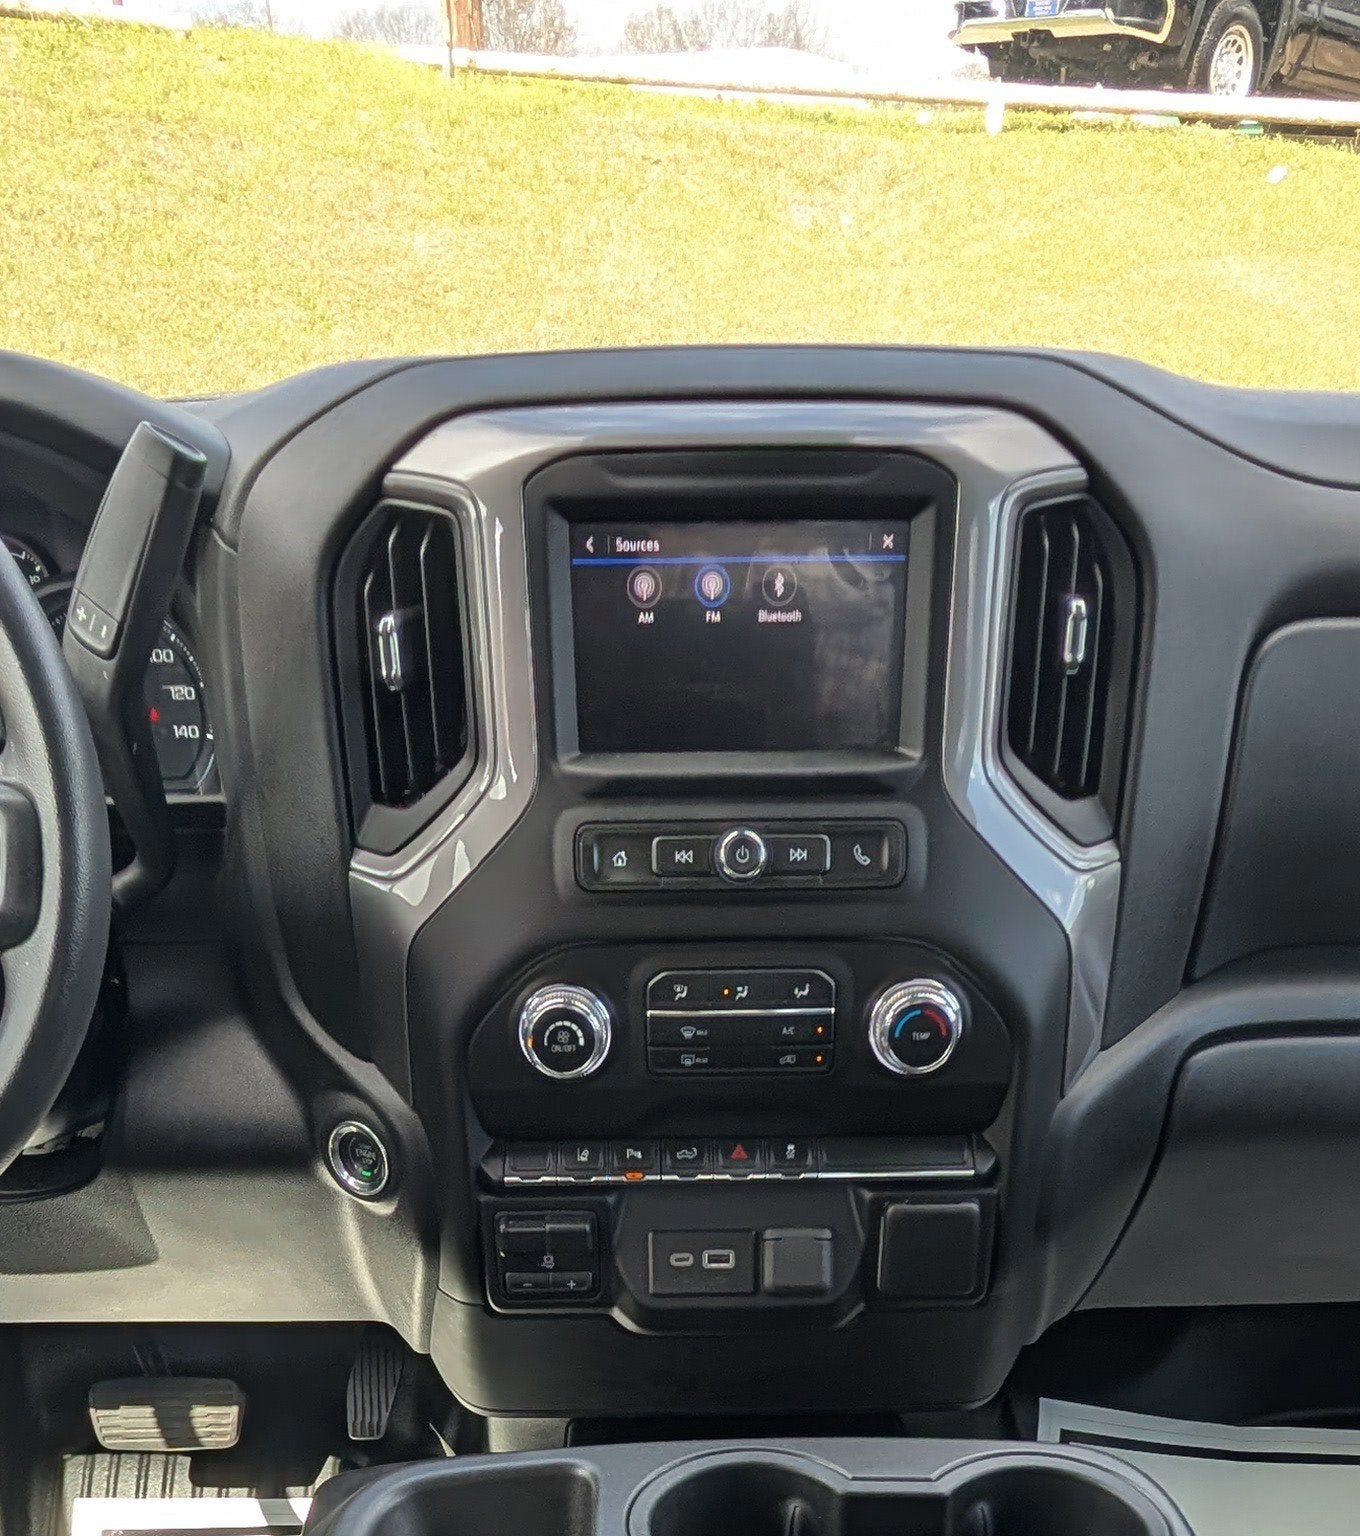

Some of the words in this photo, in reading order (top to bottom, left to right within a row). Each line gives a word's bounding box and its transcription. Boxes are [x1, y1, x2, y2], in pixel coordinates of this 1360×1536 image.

[615, 536, 660, 553] Sources
[638, 611, 655, 624] AM
[705, 610, 721, 624] FM
[757, 609, 802, 623] Bluetooth
[151, 648, 174, 663] 00
[172, 724, 200, 739] 140
